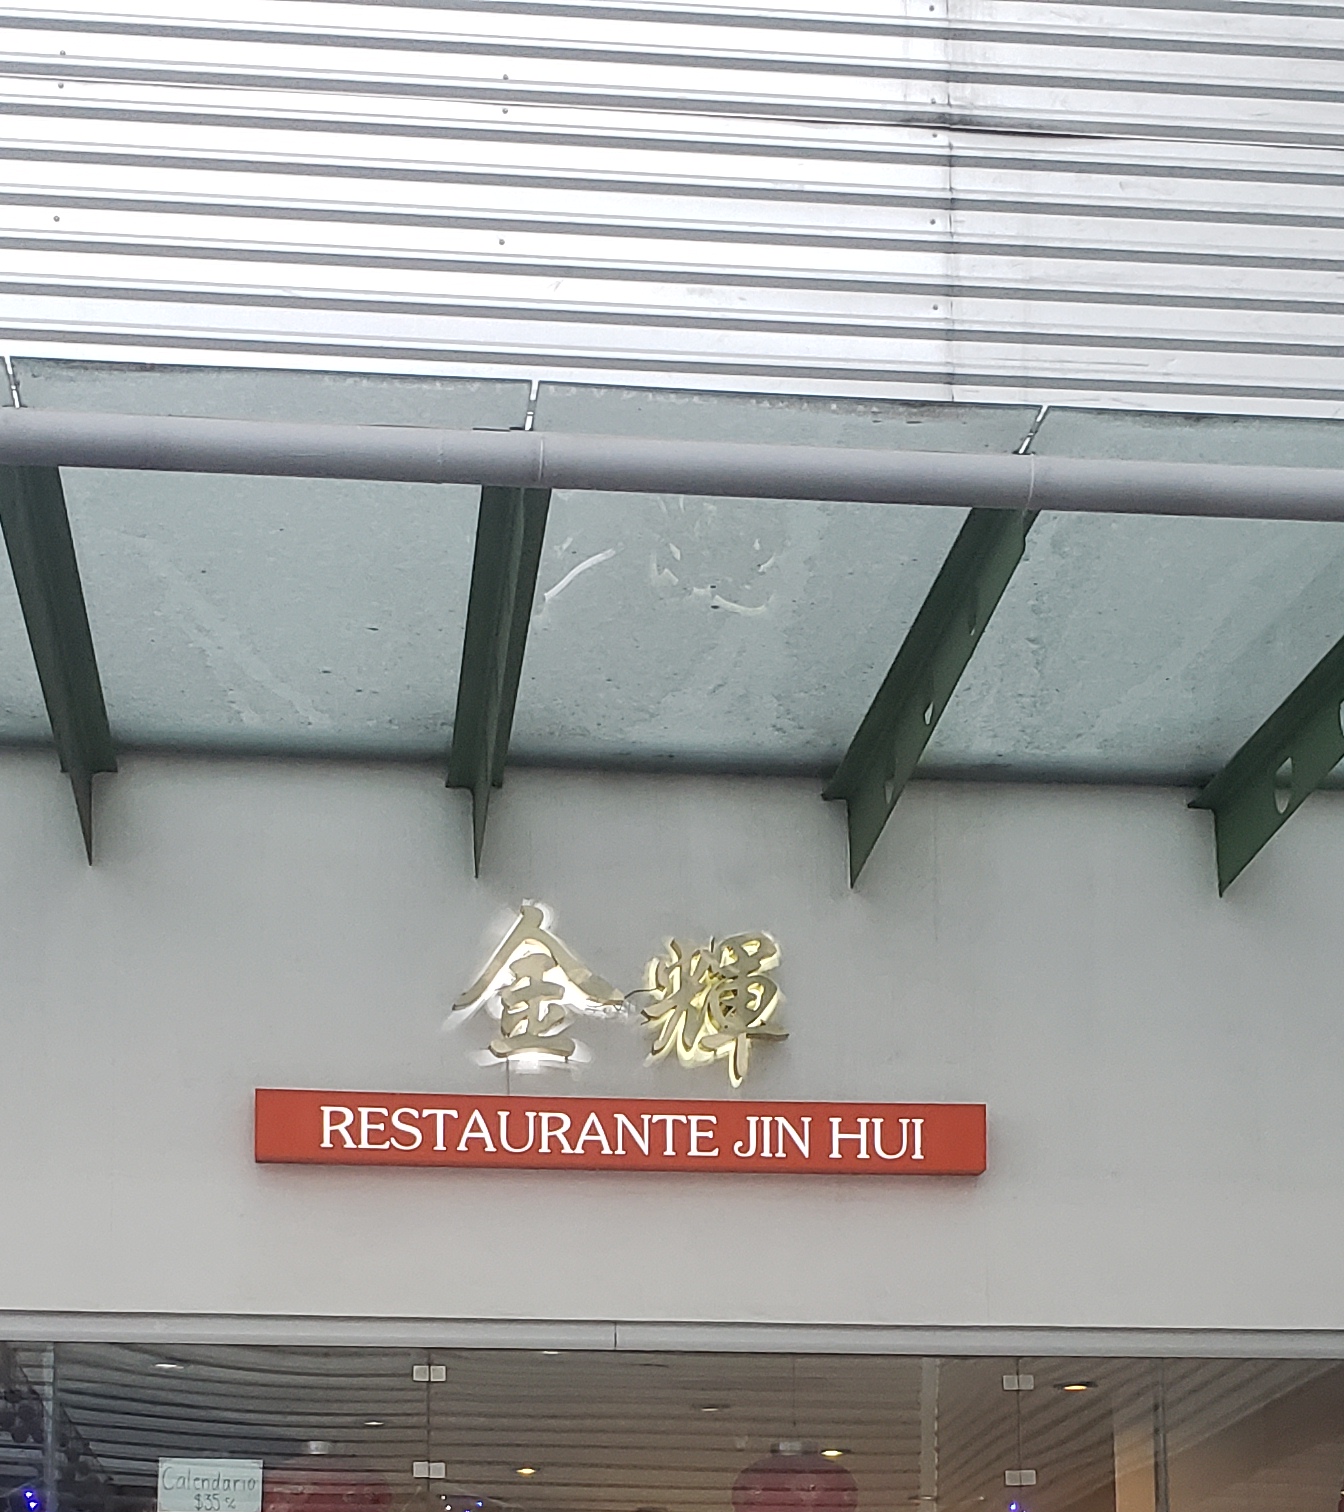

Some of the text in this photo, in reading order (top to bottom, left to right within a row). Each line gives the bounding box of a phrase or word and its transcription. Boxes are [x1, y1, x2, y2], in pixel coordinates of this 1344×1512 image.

[320, 1105, 925, 1161] RESTAURANTE JIN HUI
[162, 1467, 256, 1491] Calendario
[194, 1493, 221, 1511] $35
